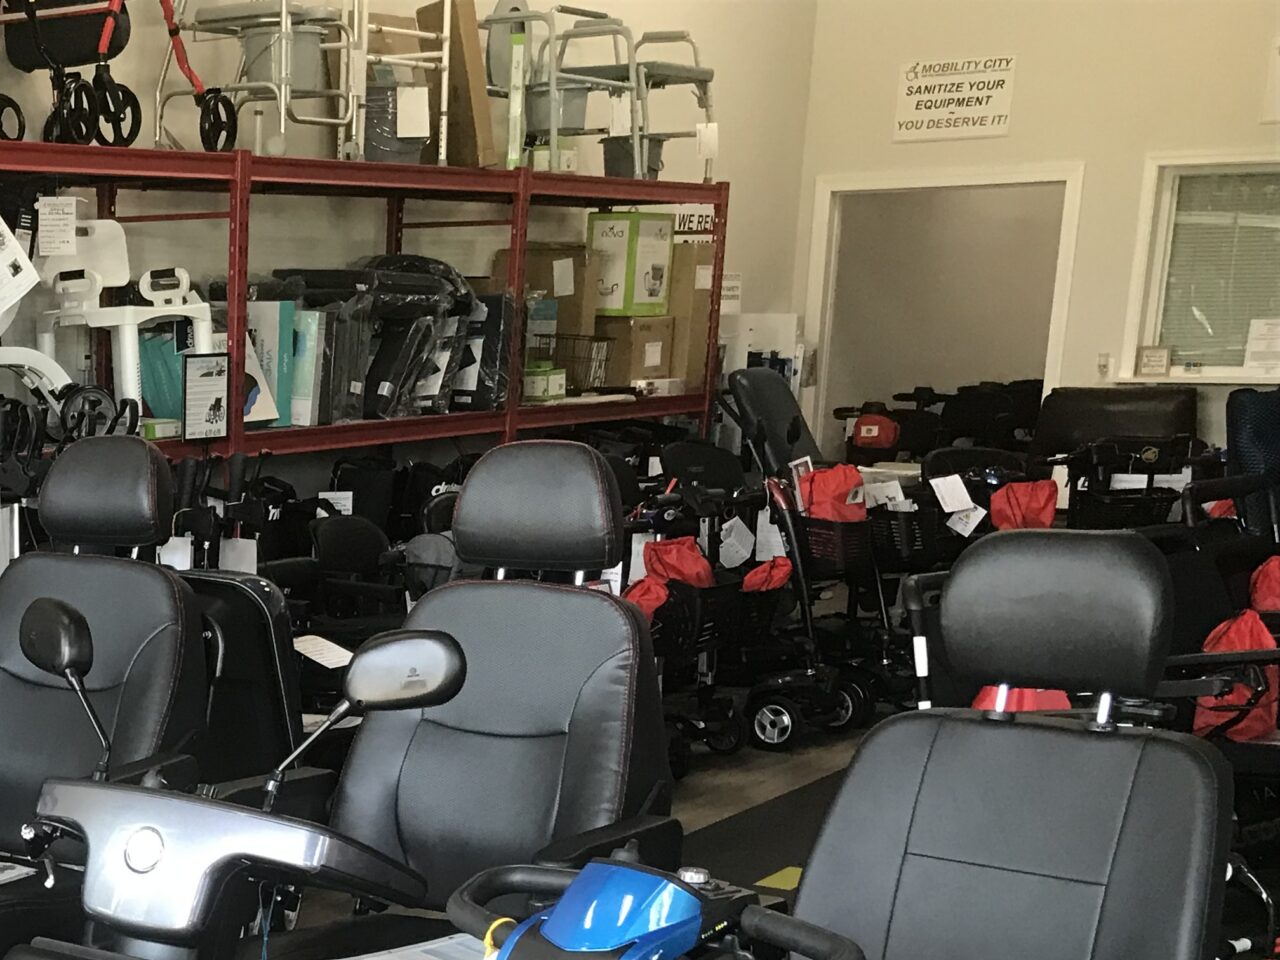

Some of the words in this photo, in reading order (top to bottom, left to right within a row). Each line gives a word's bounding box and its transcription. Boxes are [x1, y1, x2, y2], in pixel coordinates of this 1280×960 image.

[921, 60, 982, 74] MOBILITY
[983, 57, 1013, 70] CITY
[905, 81, 965, 97] SANITIZE
[968, 79, 1006, 92] YOUR
[914, 95, 993, 111] EQUIPMENT
[897, 119, 924, 131] YOU
[926, 115, 989, 129] DESERVE
[991, 114, 1009, 126] IT!
[678, 213, 695, 231] WE
